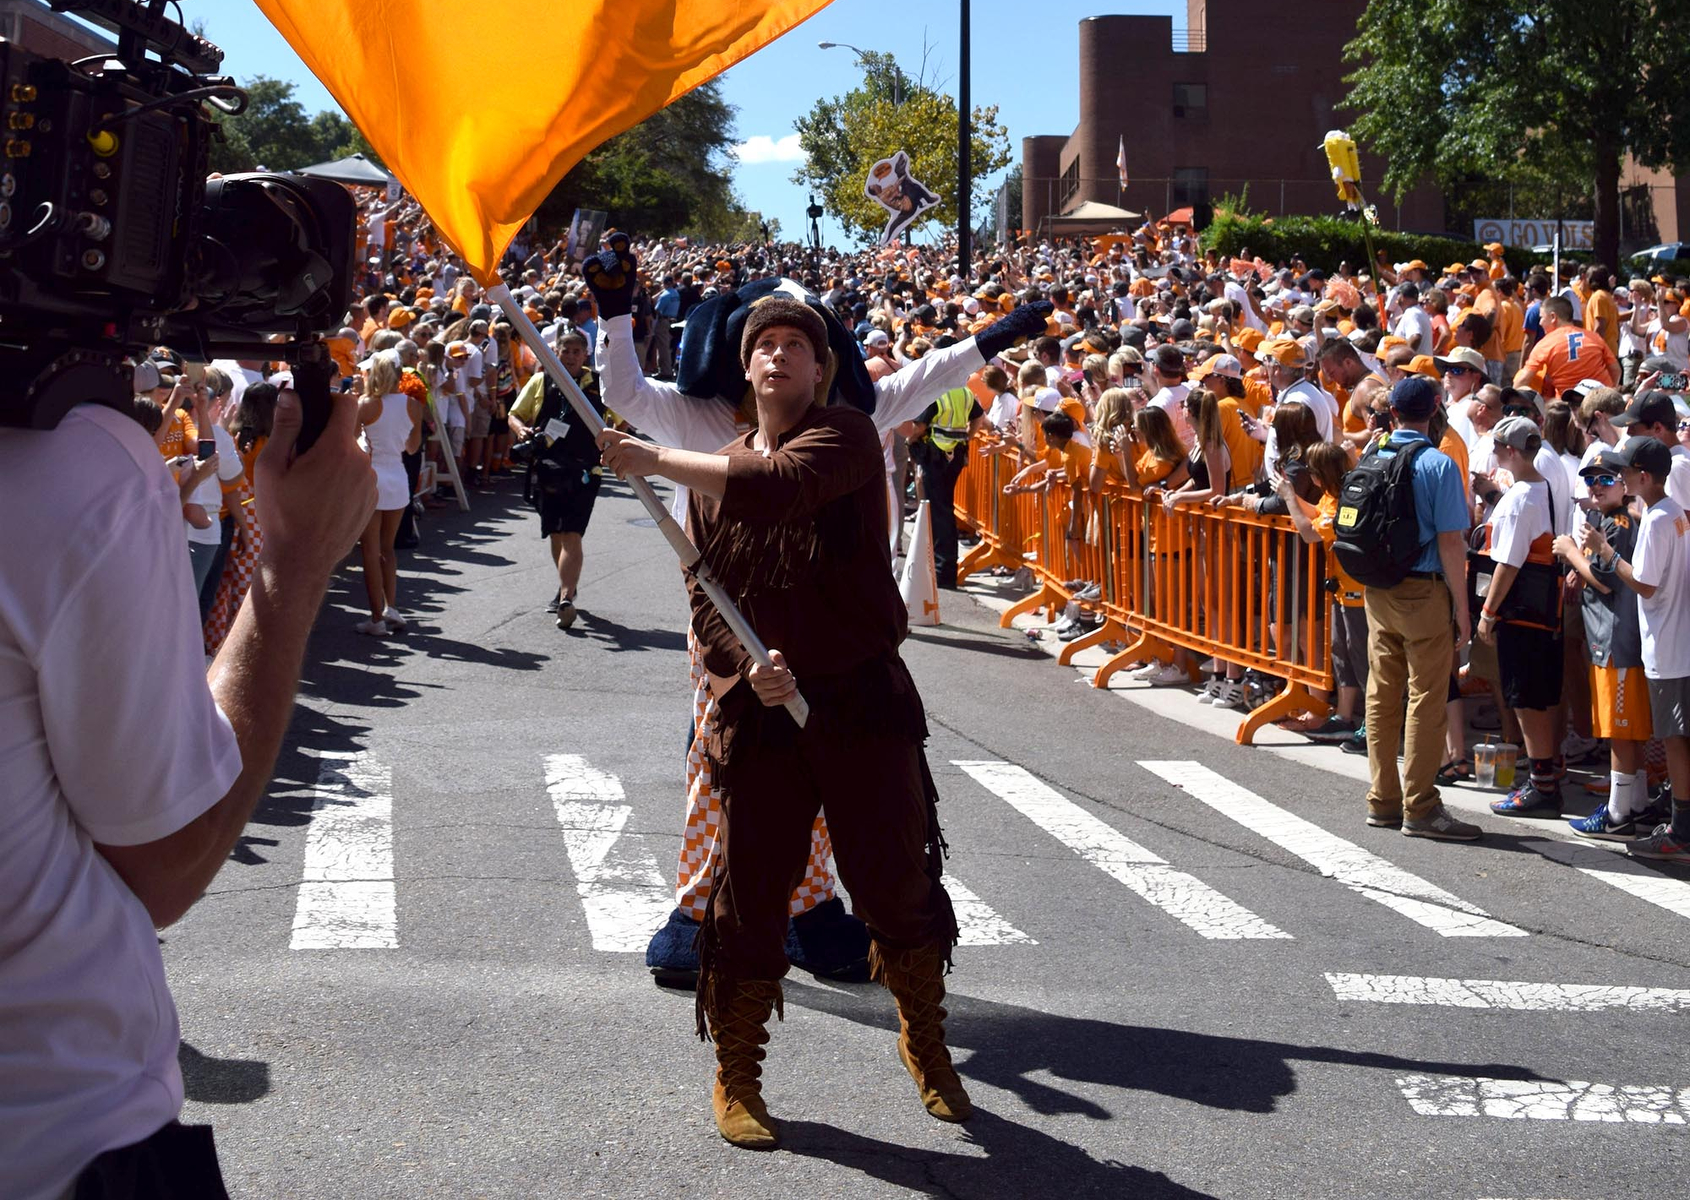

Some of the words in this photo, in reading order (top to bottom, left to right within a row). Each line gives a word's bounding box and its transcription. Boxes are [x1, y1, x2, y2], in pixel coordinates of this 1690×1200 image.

[1510, 222, 1539, 247] GO
[1541, 223, 1594, 248] VOLS
[1567, 332, 1585, 362] F
